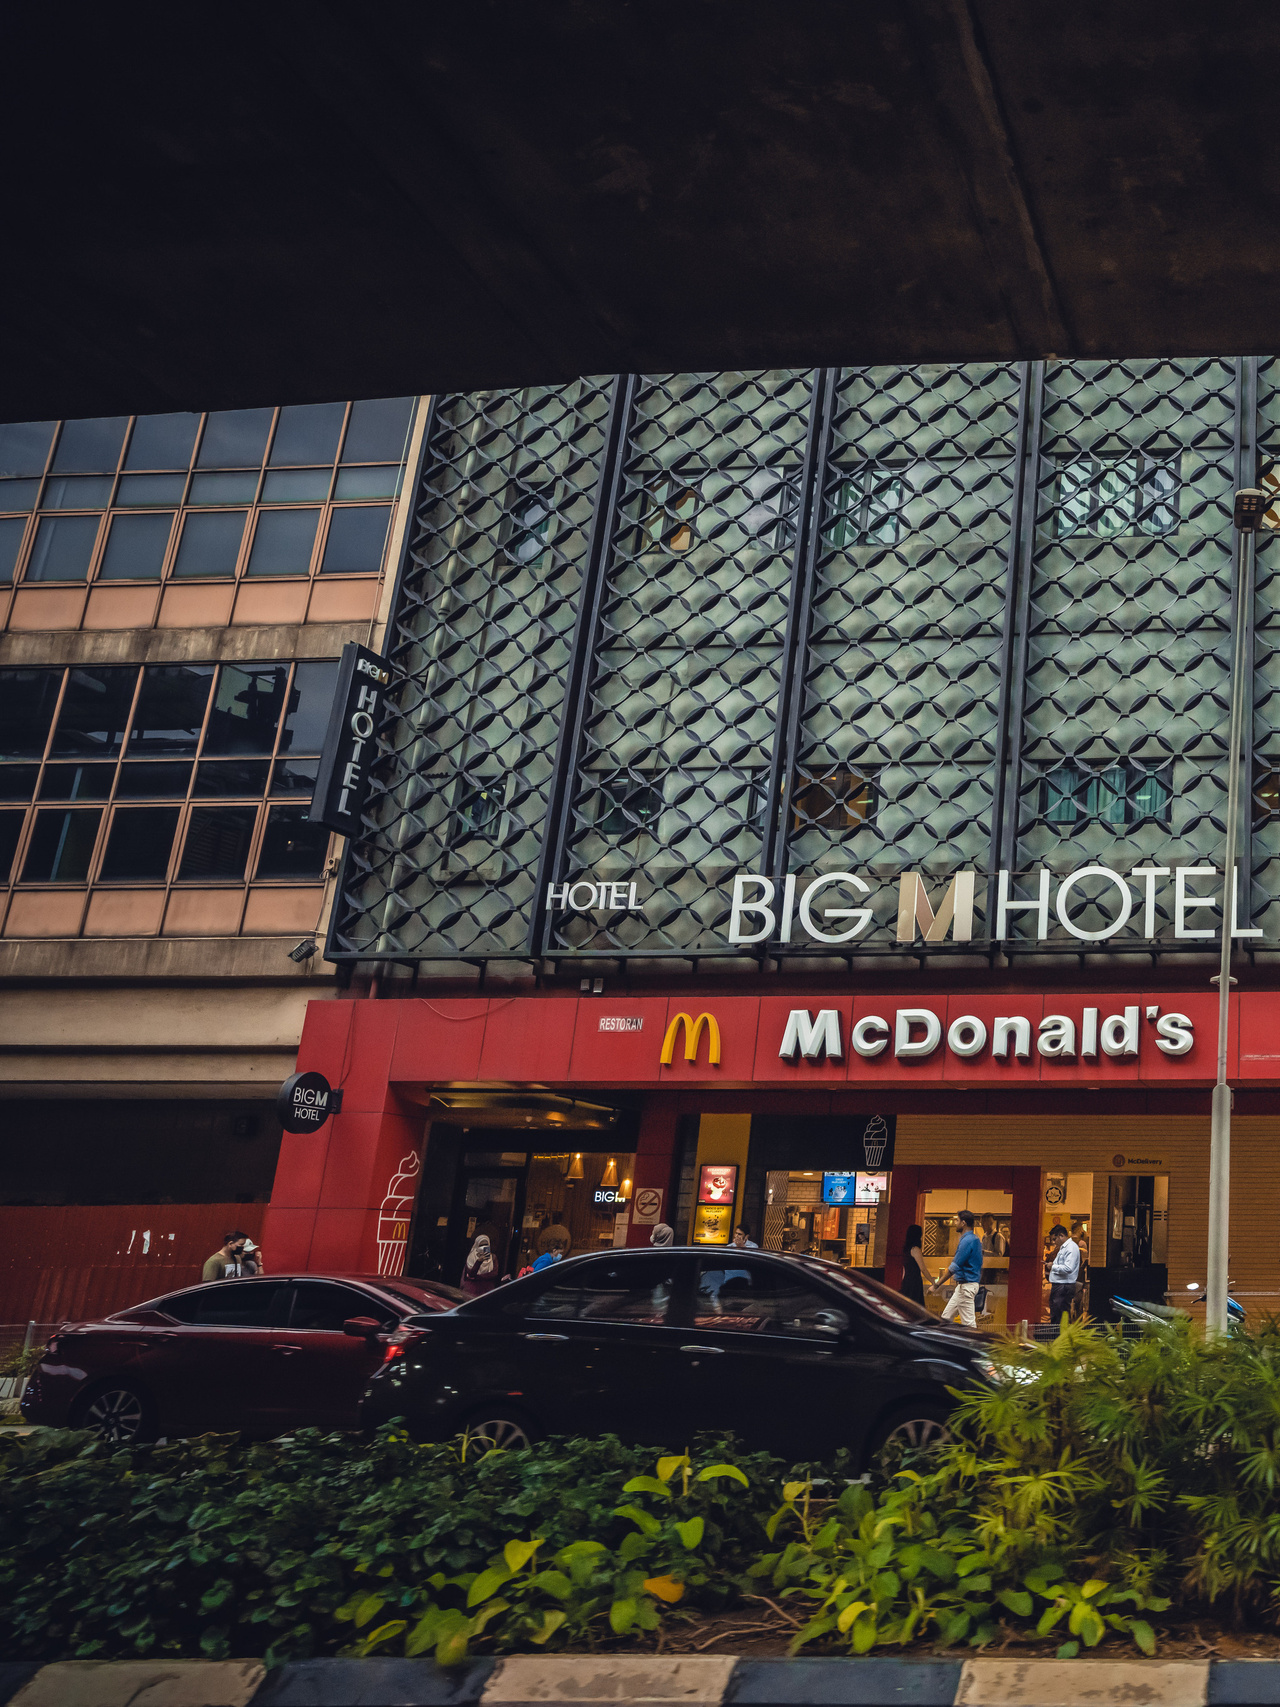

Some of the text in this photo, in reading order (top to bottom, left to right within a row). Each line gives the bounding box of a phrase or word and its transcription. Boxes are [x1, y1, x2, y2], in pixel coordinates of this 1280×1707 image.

[337, 685, 377, 816] HOTEL
[545, 881, 644, 911] HOTEL
[728, 866, 1263, 943] BIG M HOTEL
[599, 1018, 643, 1031] RESTORAN
[778, 1005, 1194, 1059] McDonald's
[294, 1107, 320, 1121] HOTEL
